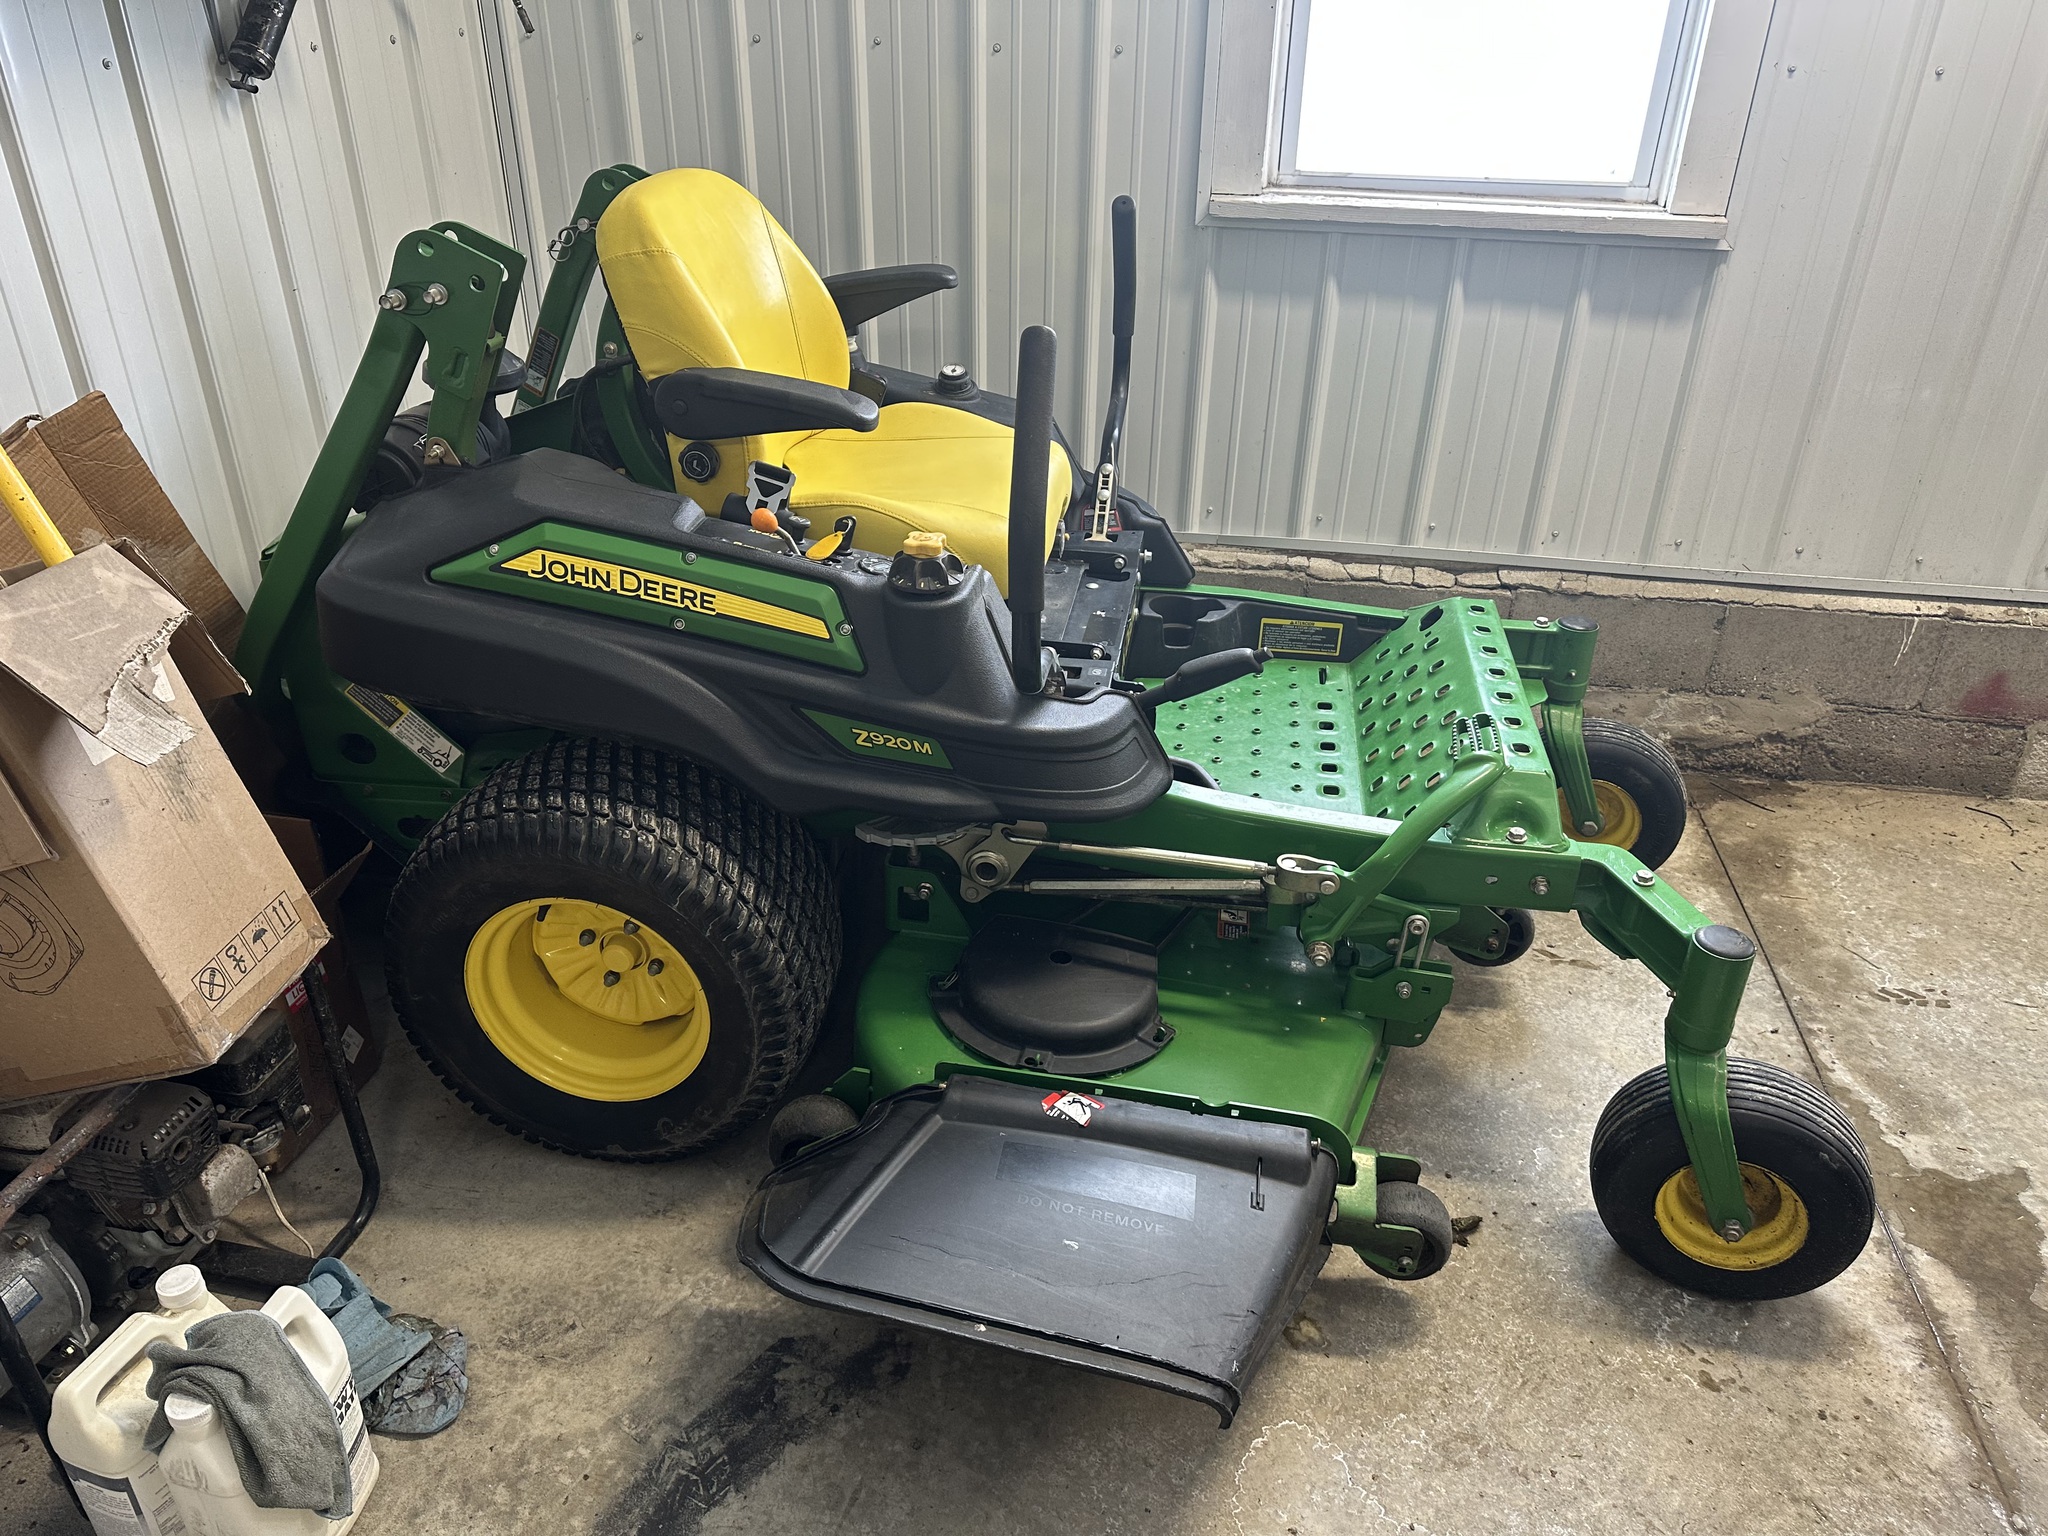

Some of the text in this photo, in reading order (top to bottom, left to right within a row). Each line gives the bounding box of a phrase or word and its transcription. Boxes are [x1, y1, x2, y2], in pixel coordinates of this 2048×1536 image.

[531, 554, 717, 613] JOHN DEERE
[852, 728, 933, 755] Z920M
[1017, 1194, 1165, 1234] DO NOT REMOVE
